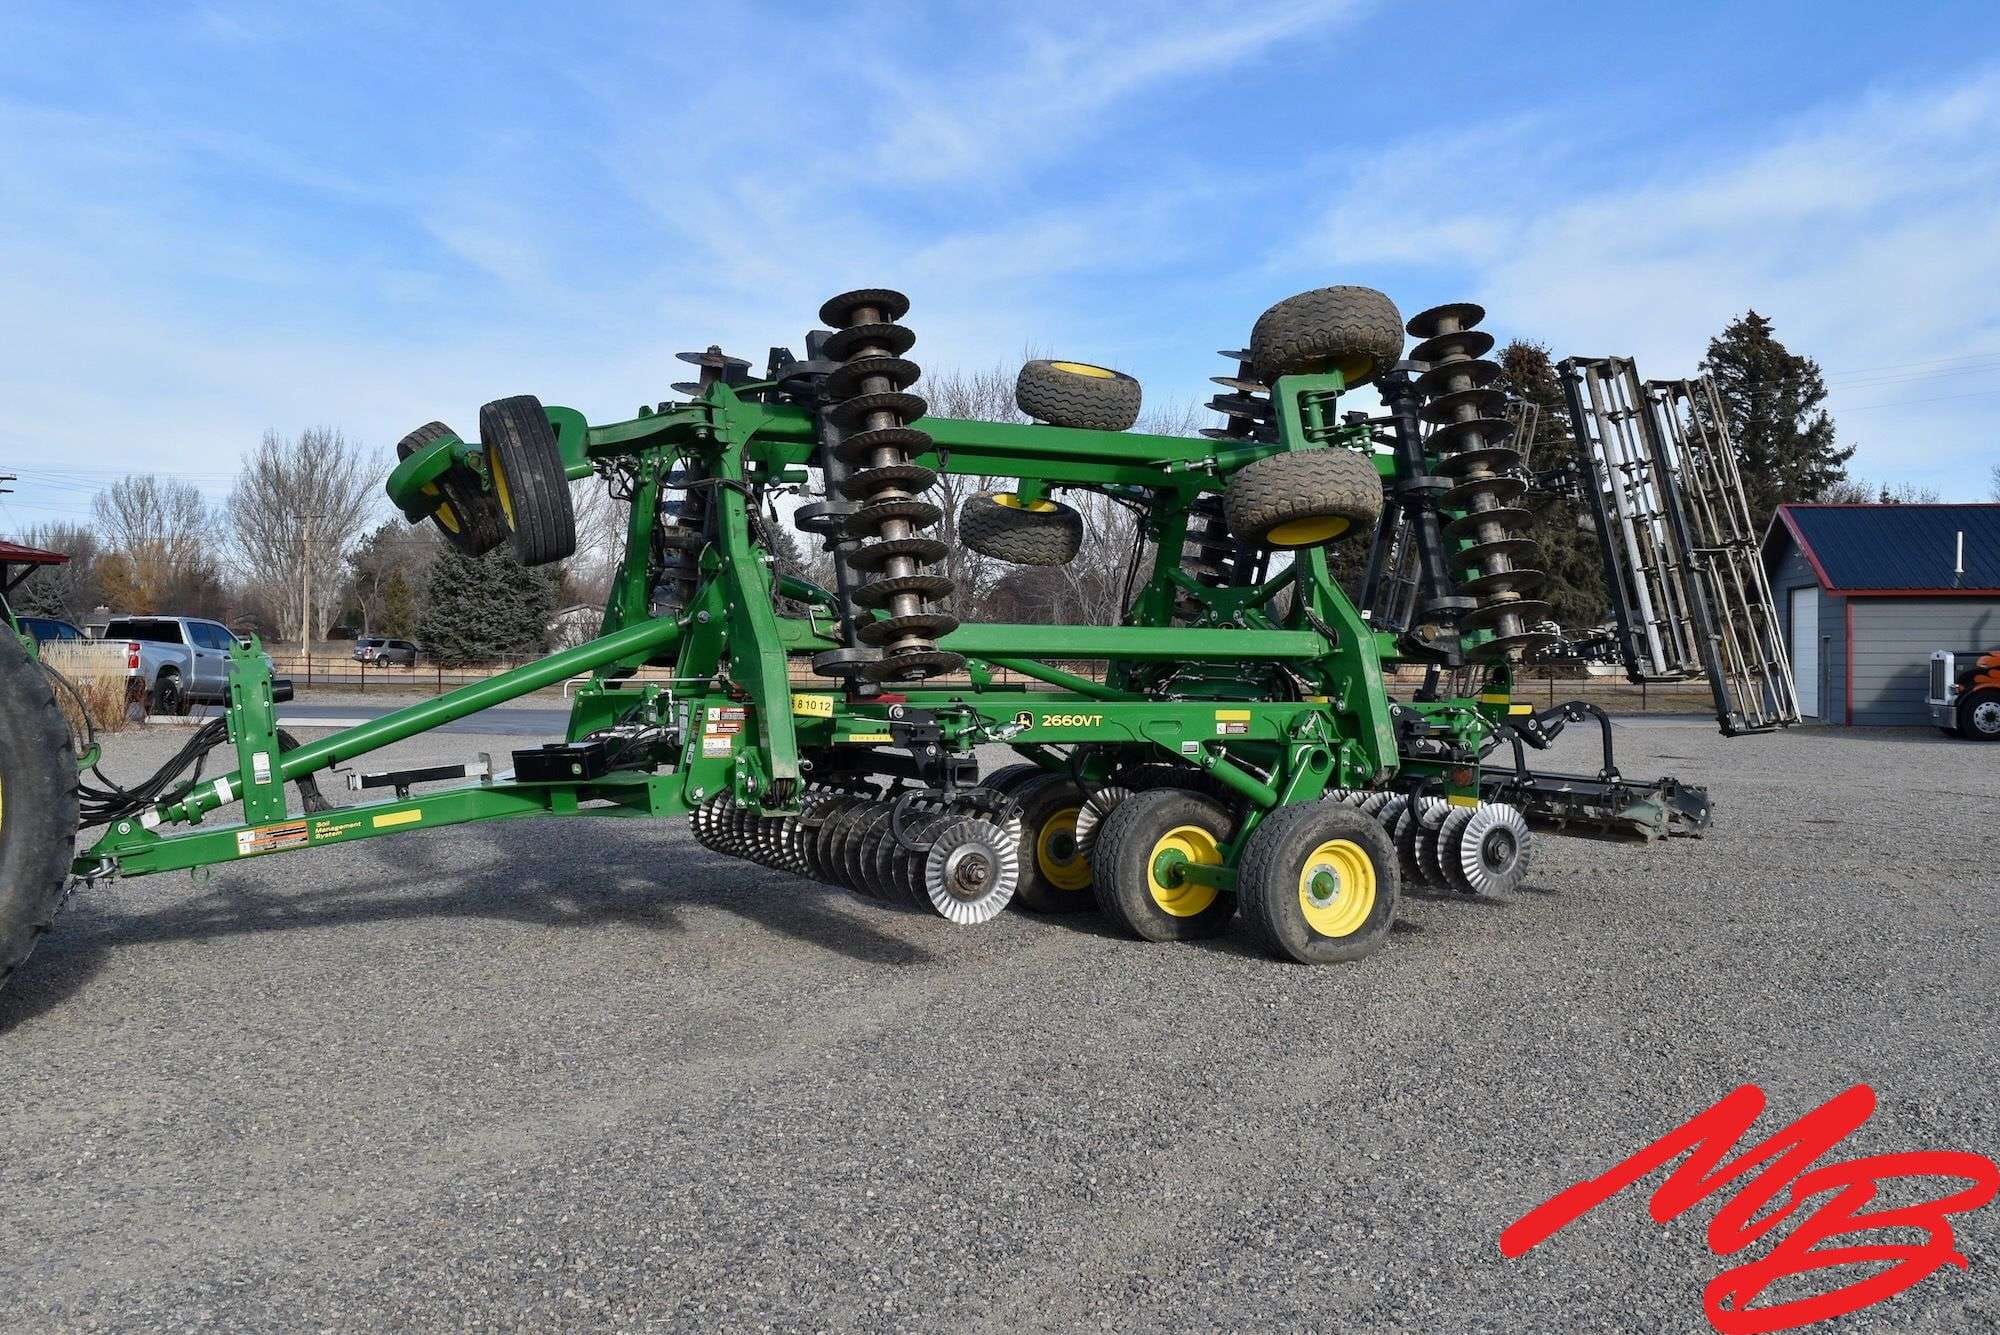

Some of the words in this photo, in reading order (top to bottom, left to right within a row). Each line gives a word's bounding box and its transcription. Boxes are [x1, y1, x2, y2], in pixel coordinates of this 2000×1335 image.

[1041, 714, 1103, 727] 2660VT
[314, 821, 362, 834] Management
[315, 820, 331, 828] Soil
[314, 830, 343, 840] System
